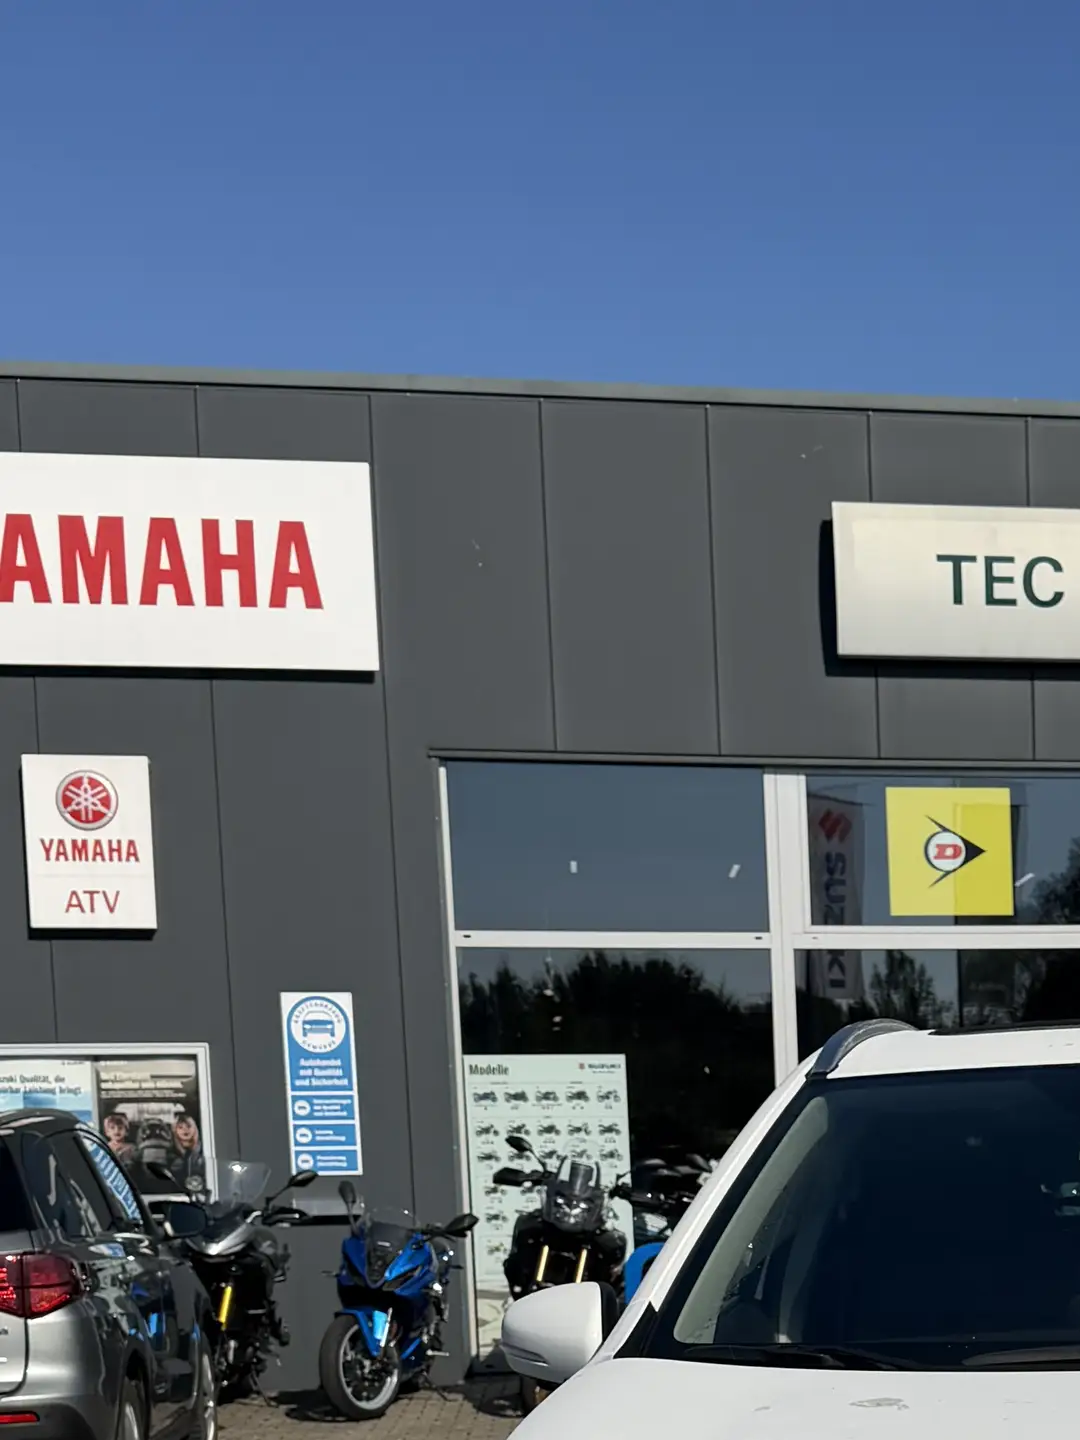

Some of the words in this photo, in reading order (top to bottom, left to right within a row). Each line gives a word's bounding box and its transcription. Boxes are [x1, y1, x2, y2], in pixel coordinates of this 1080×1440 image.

[936, 554, 1065, 608] TEC
[40, 838, 140, 863] YAMAHA
[65, 890, 120, 914] ATV
[823, 851, 848, 990] SUZKI
[469, 1063, 509, 1076] Modelle
